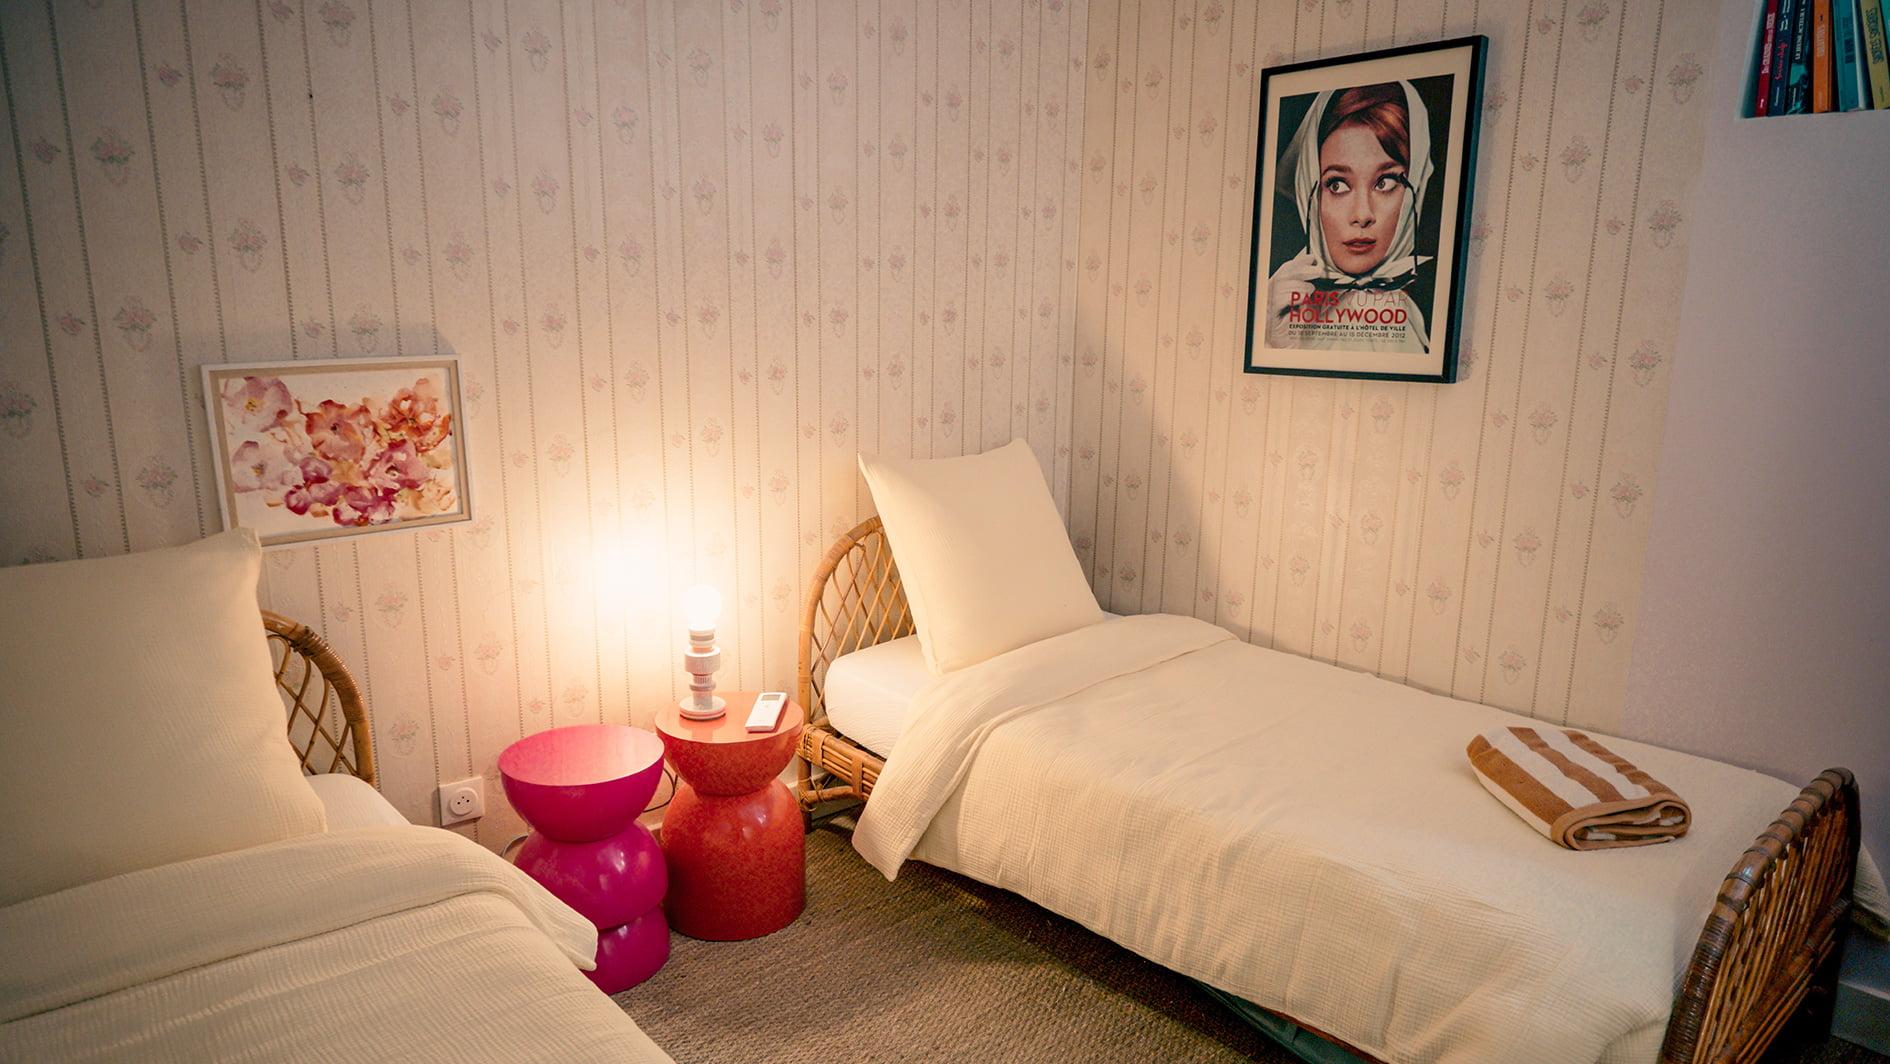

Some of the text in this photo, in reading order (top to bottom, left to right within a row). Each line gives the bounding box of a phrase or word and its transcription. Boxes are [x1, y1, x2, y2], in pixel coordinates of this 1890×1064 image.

[1291, 291, 1409, 307] PARIS VU PAR
[1289, 308, 1407, 324] HOLLYWOOD
